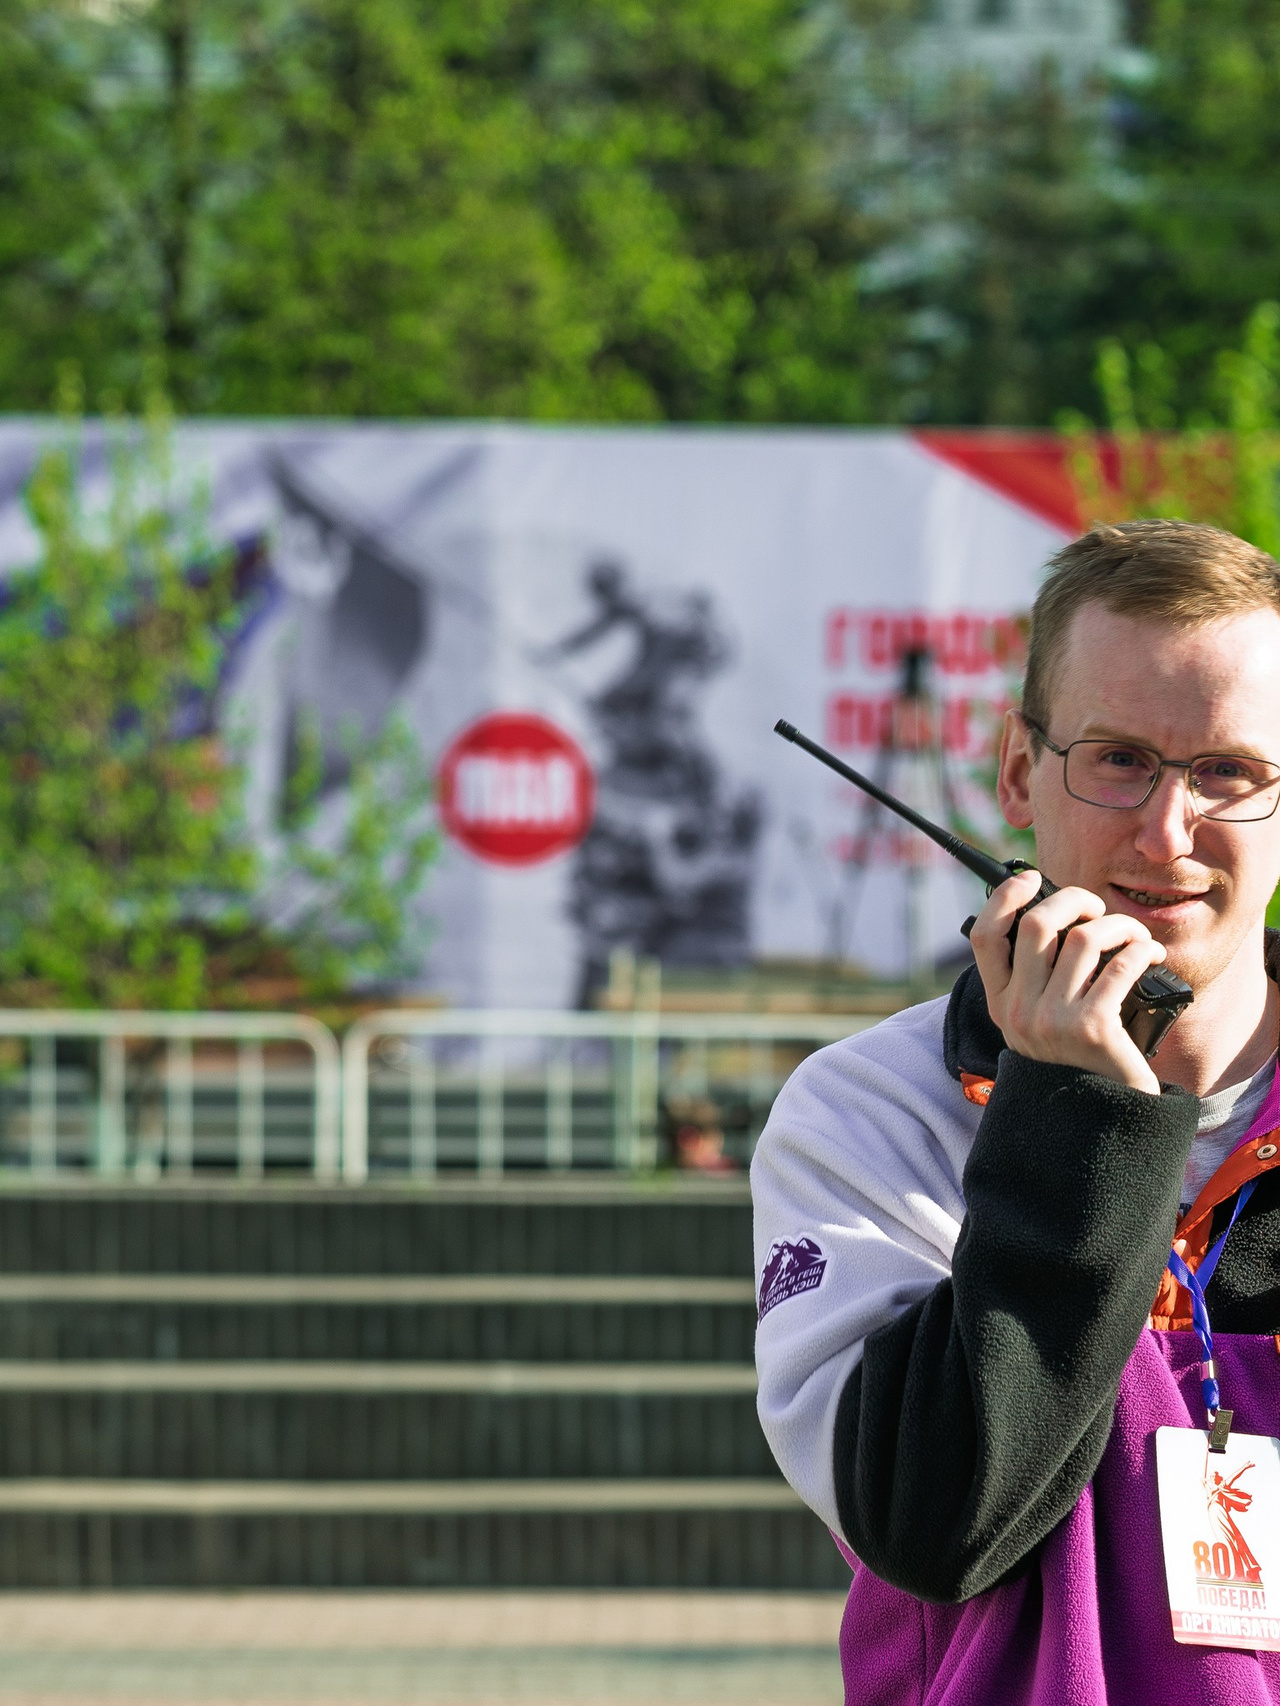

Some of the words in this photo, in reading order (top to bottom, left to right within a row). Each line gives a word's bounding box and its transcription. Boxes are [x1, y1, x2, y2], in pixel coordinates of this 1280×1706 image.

[791, 1276, 819, 1294] КЭШ
[1193, 1540, 1231, 1580] 80
[1197, 1586, 1267, 1611] ПОБЕДА!
